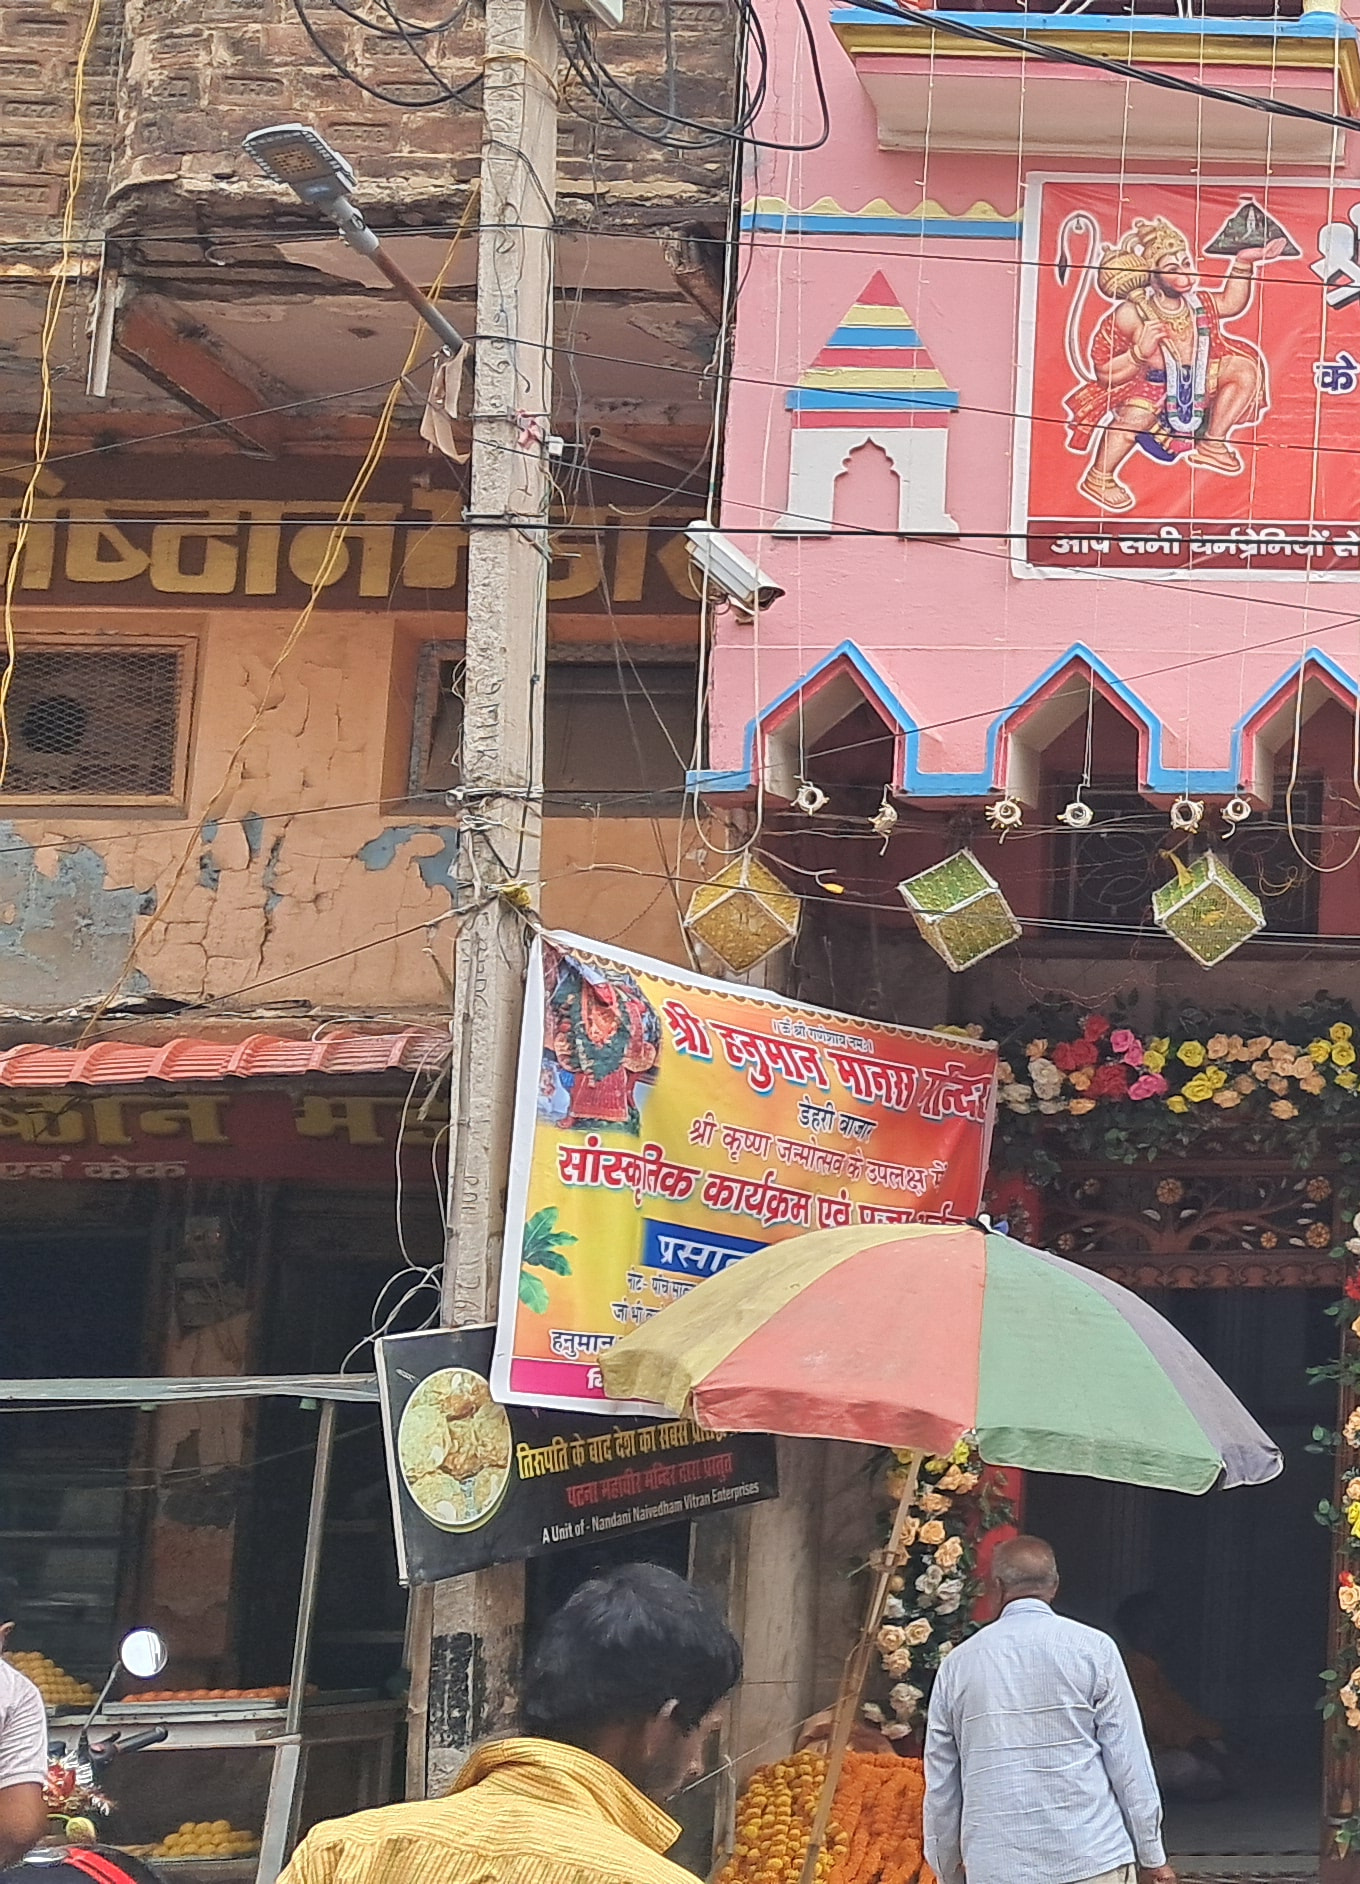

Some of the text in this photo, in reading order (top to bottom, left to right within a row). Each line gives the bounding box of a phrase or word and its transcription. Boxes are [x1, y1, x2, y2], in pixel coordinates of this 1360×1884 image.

[1316, 352, 1358, 395] के
[1050, 533, 1111, 556] आप
[1332, 530, 1359, 559] से
[662, 1001, 711, 1058] श्री
[709, 1021, 830, 1094] हनुमान
[827, 1050, 918, 1111] मानस
[798, 1095, 878, 1143] डेहरी बाजार
[688, 1112, 717, 1149] श्री
[720, 1125, 773, 1163] कृष्ण
[775, 1136, 847, 1180] जन्मोत्सव
[846, 1149, 865, 1182] के
[928, 1160, 949, 1193] में
[557, 1133, 703, 1209] सांस्कृतिक
[701, 1170, 815, 1229] कार्यक्रम
[815, 1188, 852, 1230] एवं
[549, 1330, 615, 1360] हनुमान
[516, 1435, 569, 1480] तिरुपति
[570, 1432, 587, 1468] के
[587, 1433, 614, 1466] बाद
[614, 1424, 637, 1459] देश
[639, 1425, 657, 1452] का
[542, 1480, 760, 1544] A Unit of Nandani Naivedham Vitran Enterprises
